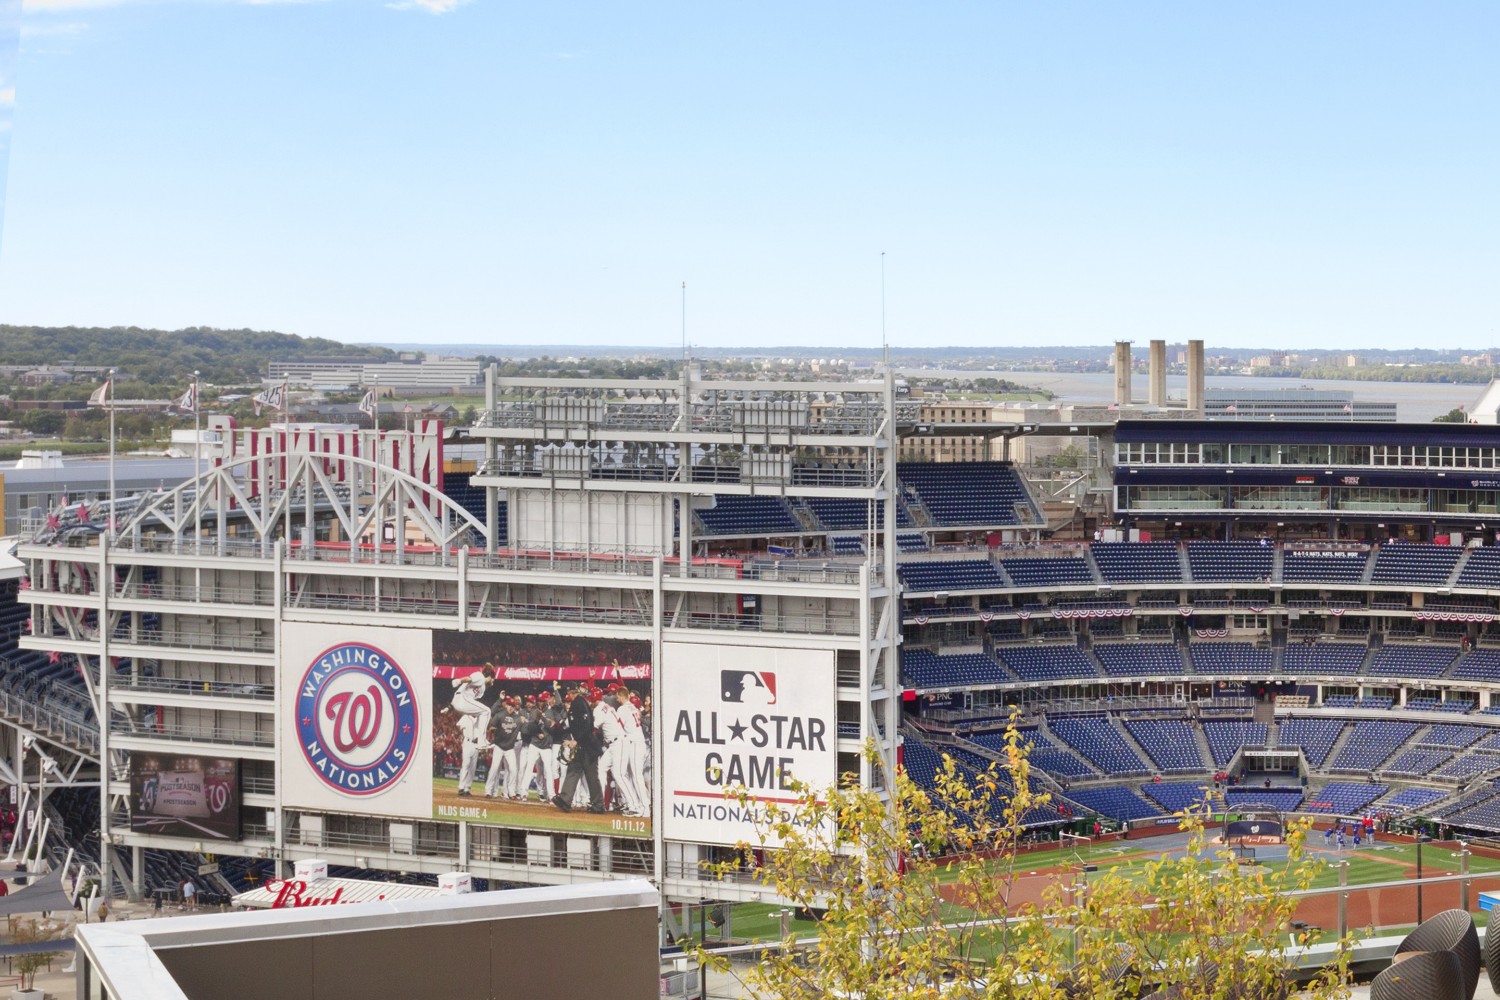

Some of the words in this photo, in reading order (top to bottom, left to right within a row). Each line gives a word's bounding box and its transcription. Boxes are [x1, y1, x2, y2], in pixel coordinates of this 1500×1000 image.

[303, 649, 411, 707] WASHINGTON
[937, 693, 952, 701] PNC
[308, 741, 406, 788] NATIONALS
[705, 752, 794, 790] GAME
[438, 805, 457, 817] NLDS
[459, 806, 480, 818] GAME
[482, 808, 487, 819] 4
[673, 803, 774, 824] NATIONALS
[612, 819, 645, 832] 10.11.12
